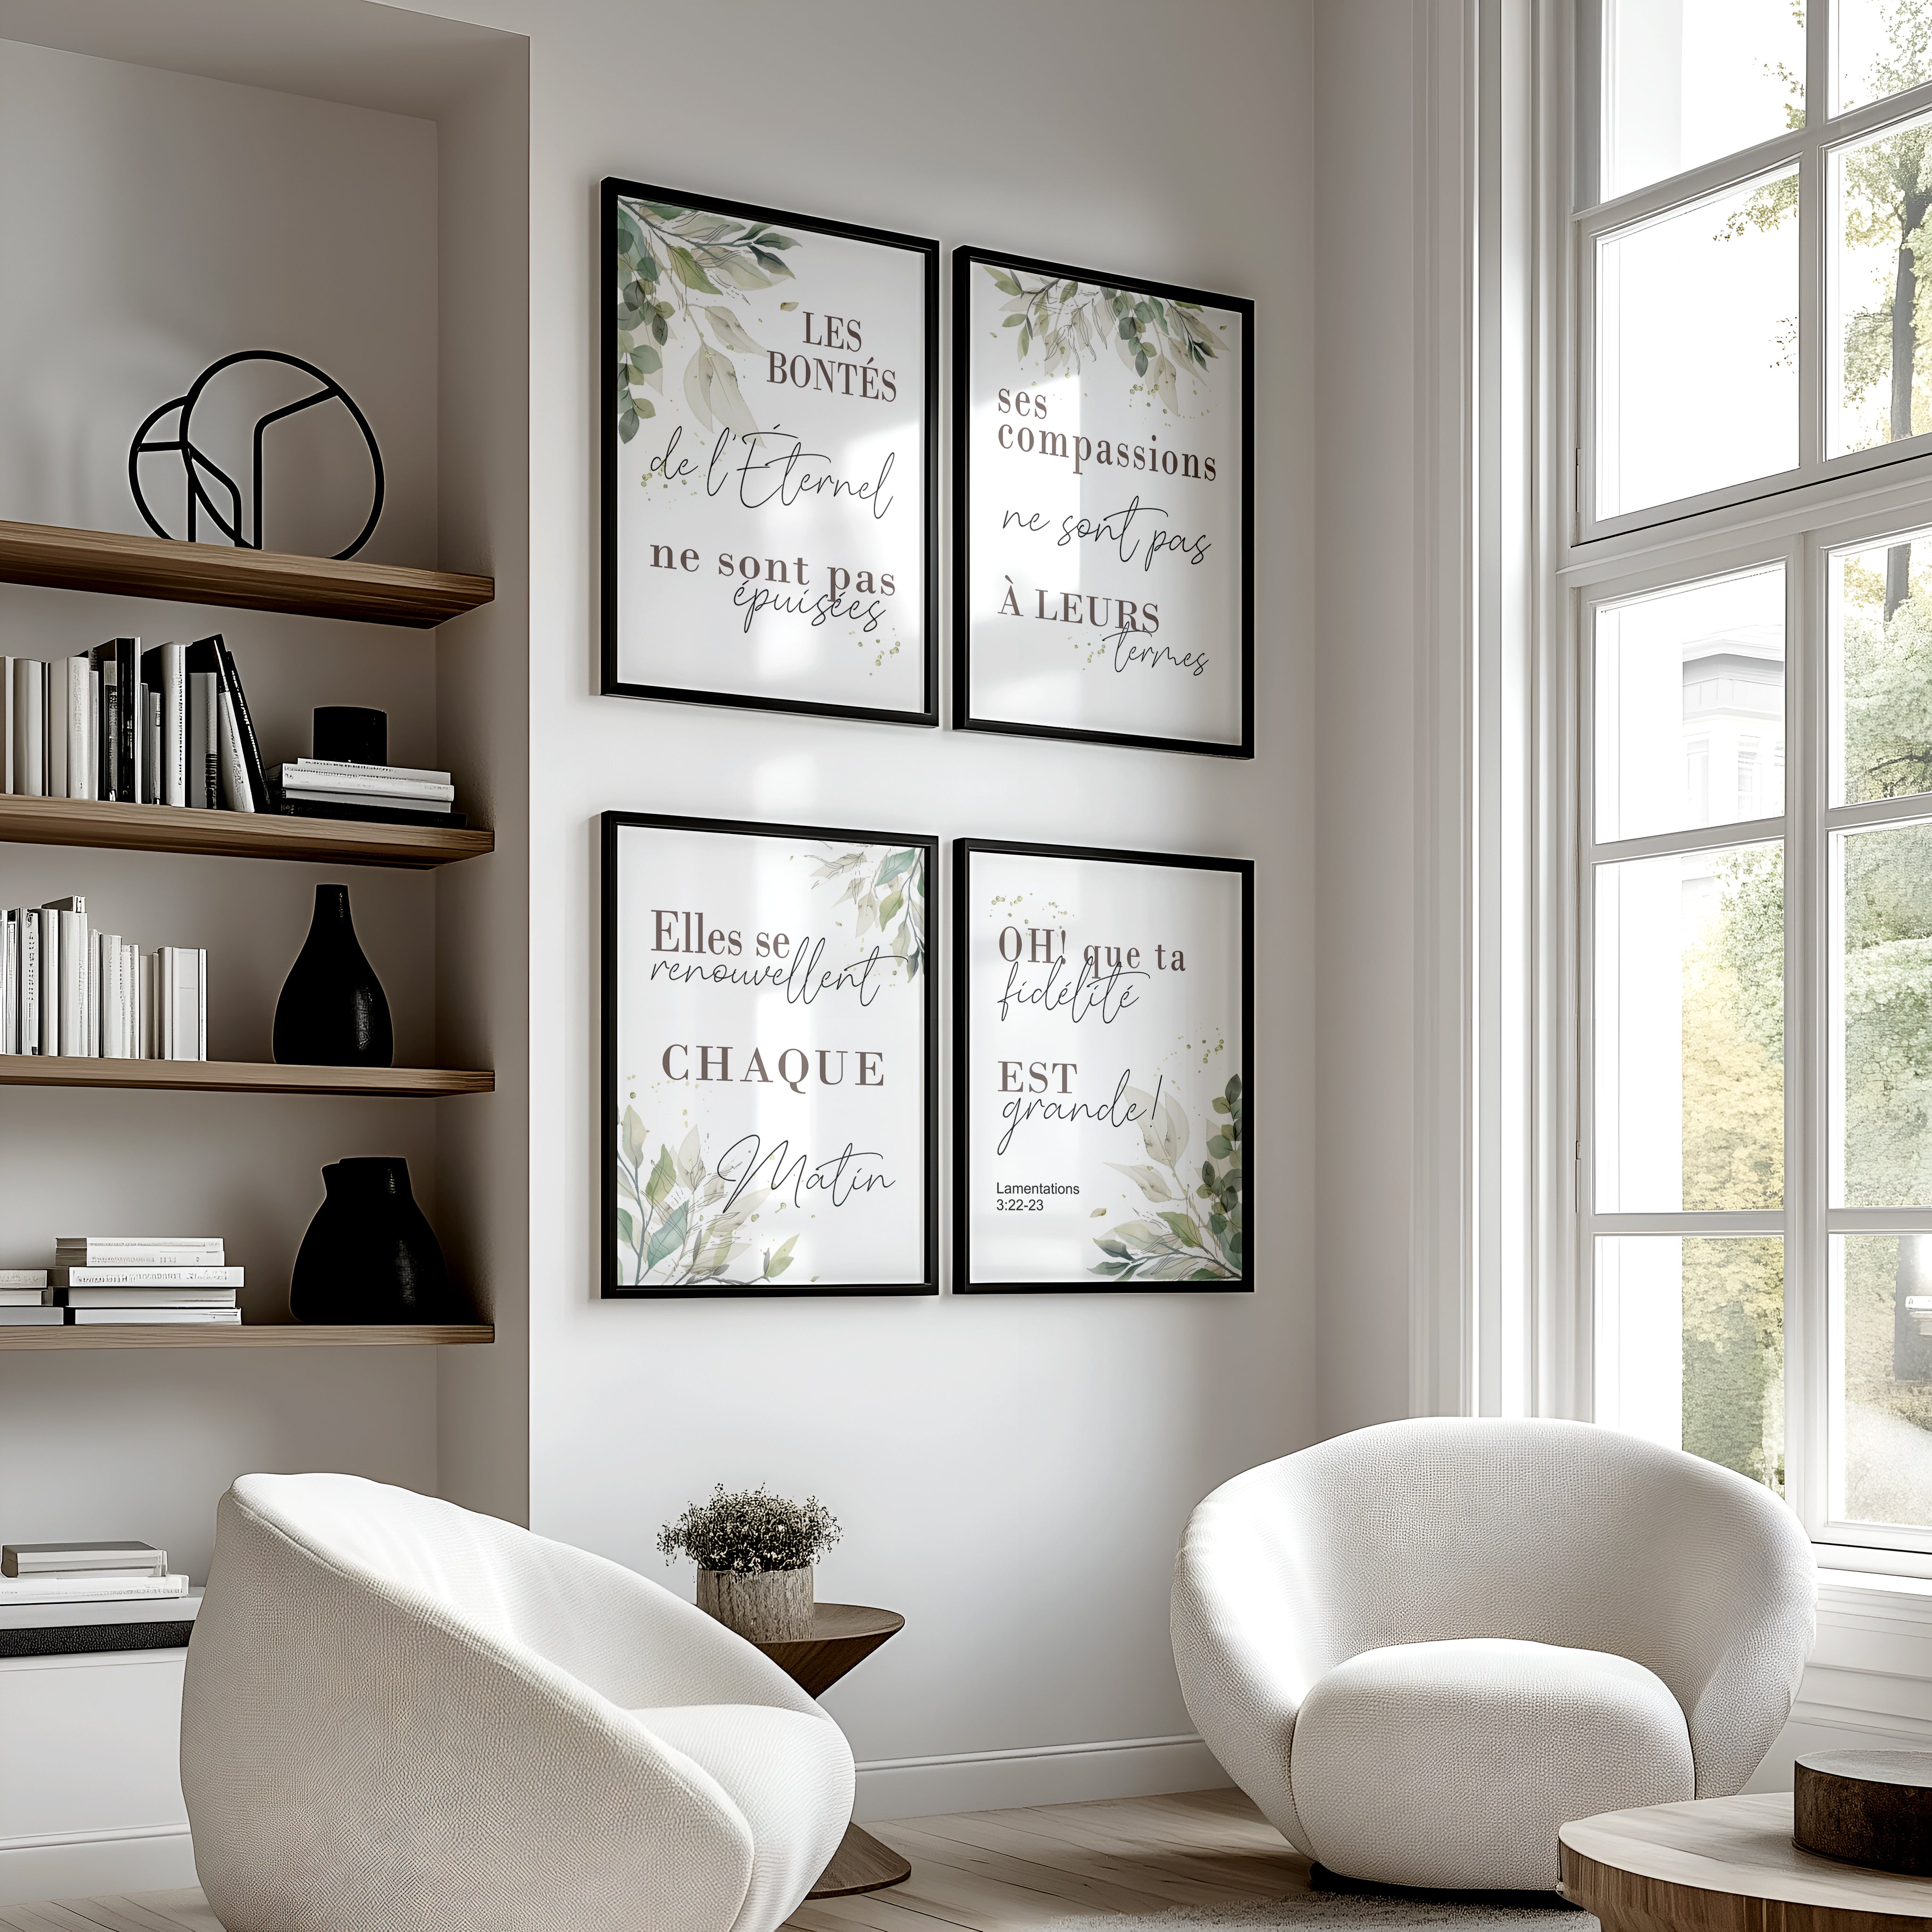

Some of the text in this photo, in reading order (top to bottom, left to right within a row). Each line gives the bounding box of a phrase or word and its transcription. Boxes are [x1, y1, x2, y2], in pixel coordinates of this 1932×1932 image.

[803, 311, 862, 352] LES
[766, 350, 897, 402] BONTÉS
[998, 388, 1047, 419] ses
[650, 424, 895, 519] de l'Éternel
[998, 424, 1216, 481] compassions
[1003, 496, 1212, 571] ne sont pas
[650, 544, 896, 602] ne sont pas
[733, 580, 886, 633] épuisées
[998, 575, 1160, 633] À LEURS
[1102, 621, 1209, 676] termes
[651, 910, 790, 958] Elles se
[999, 926, 1186, 979] OH! que ta
[651, 936, 908, 1007] renouvellent
[997, 955, 1150, 1024] fidélité
[662, 1044, 884, 1094] CHAQUE
[998, 1061, 1077, 1094] EST
[717, 1135, 896, 1214] Matin
[996, 1182, 1080, 1195] Lamentations
[996, 1199, 1044, 1212] 3:22-23
